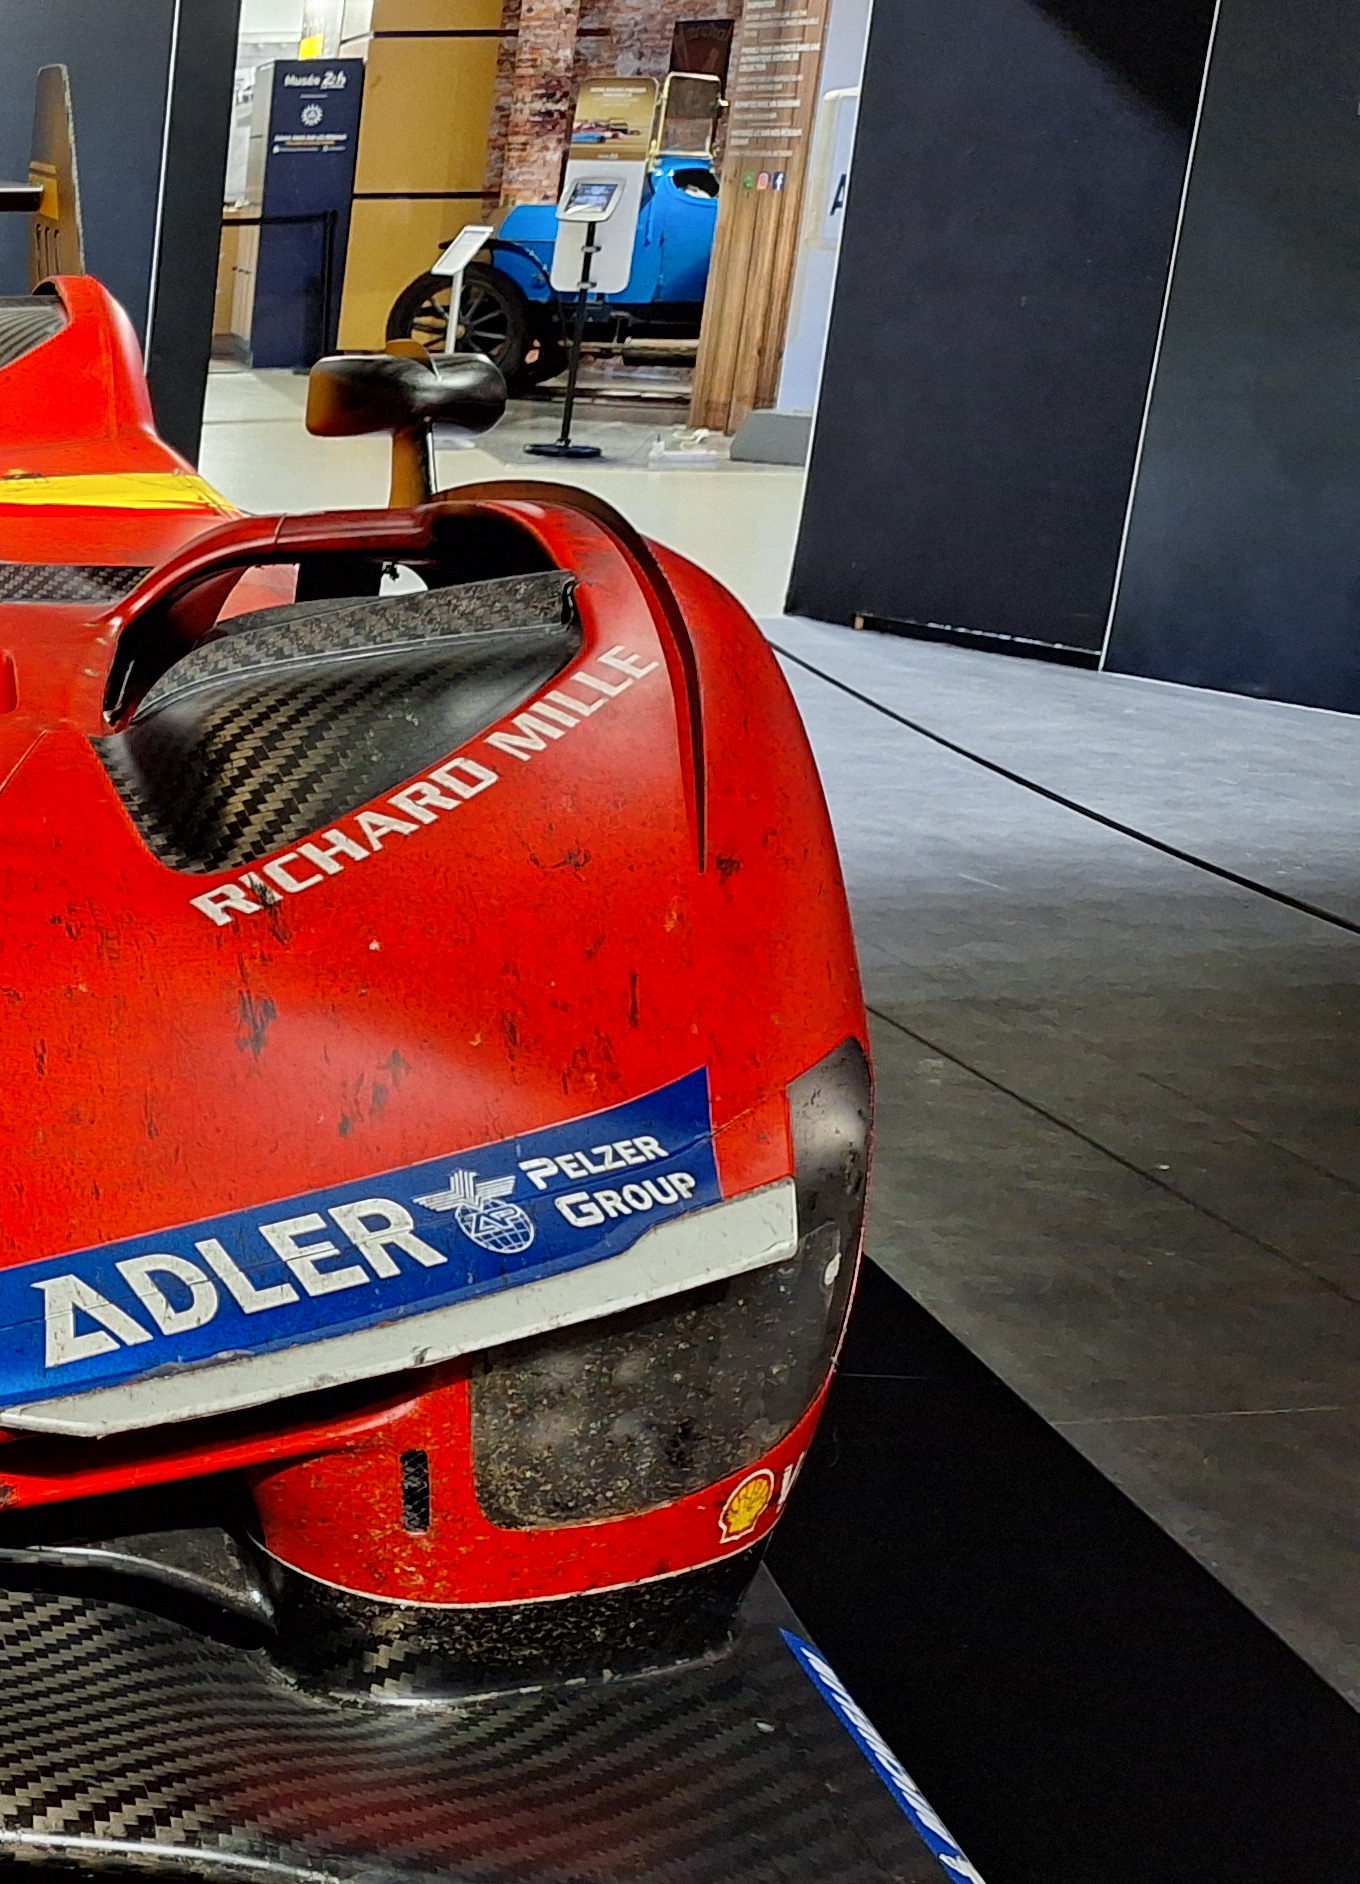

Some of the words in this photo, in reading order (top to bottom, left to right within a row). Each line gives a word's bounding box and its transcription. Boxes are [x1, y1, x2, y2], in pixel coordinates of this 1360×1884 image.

[188, 756, 501, 927] RICHARD
[483, 645, 660, 762] MILLE
[518, 1135, 669, 1191] PELZER
[553, 1171, 697, 1229] GROUP
[30, 1197, 447, 1369] ADLER
